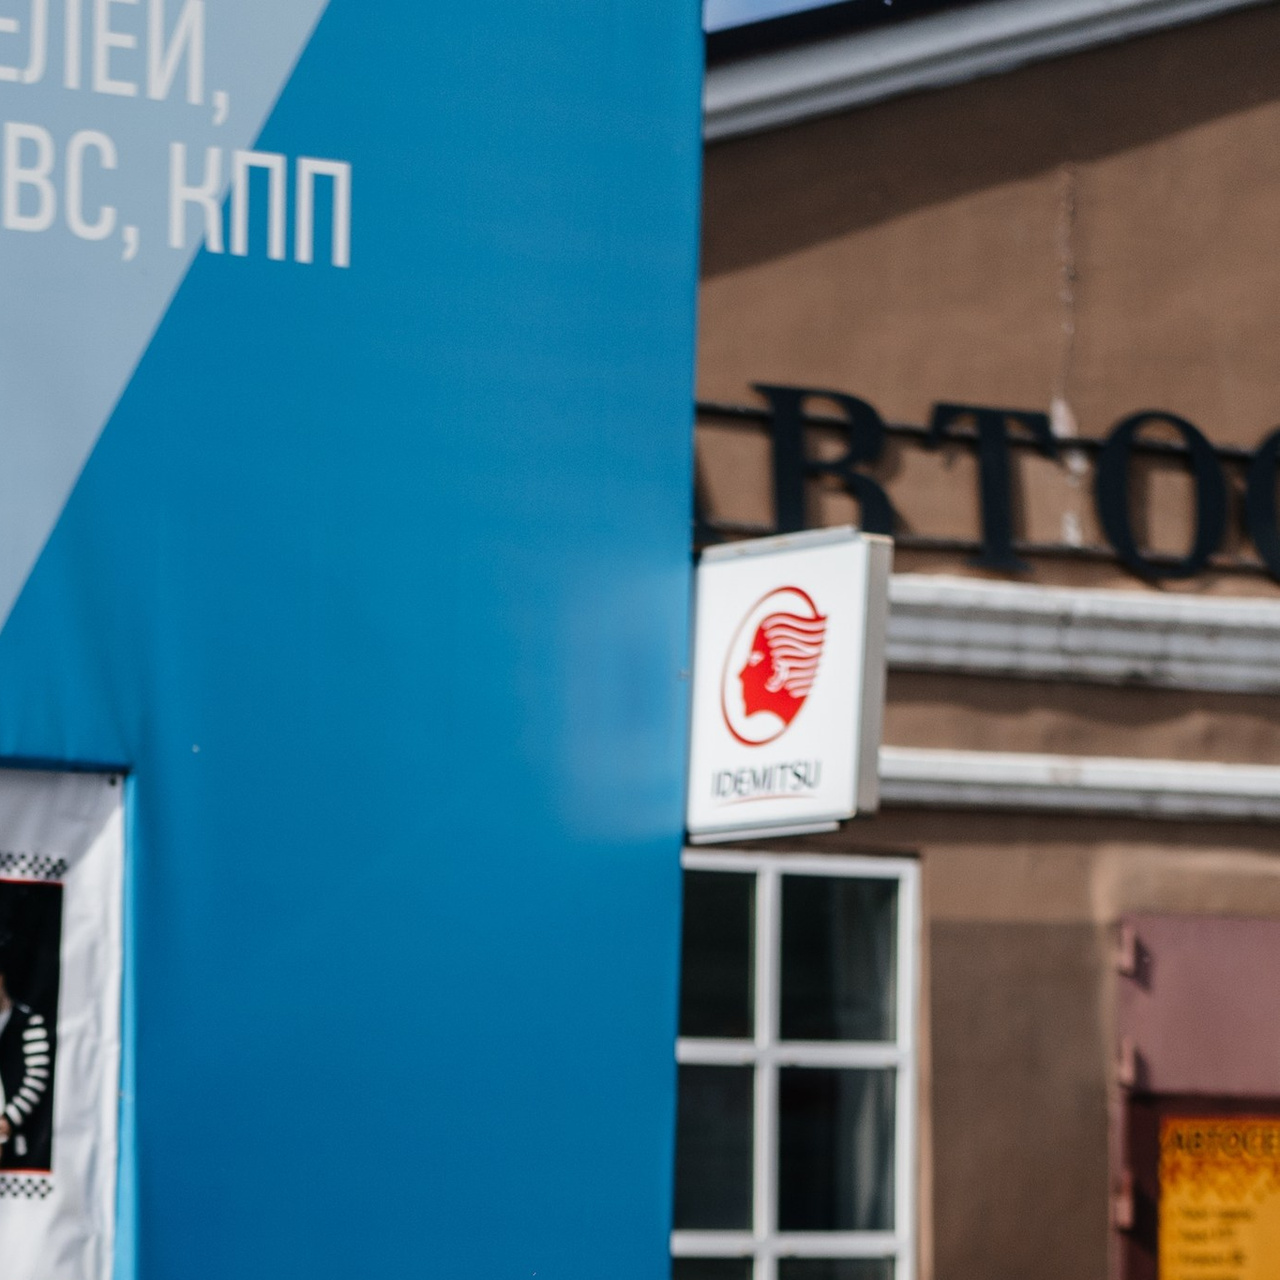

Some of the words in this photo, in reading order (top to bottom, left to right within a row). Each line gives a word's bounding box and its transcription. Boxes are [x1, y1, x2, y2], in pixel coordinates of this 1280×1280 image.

[167, 141, 352, 269] КПП
[693, 382, 1280, 586] ВТО
[711, 760, 823, 798] IDEMITSU
